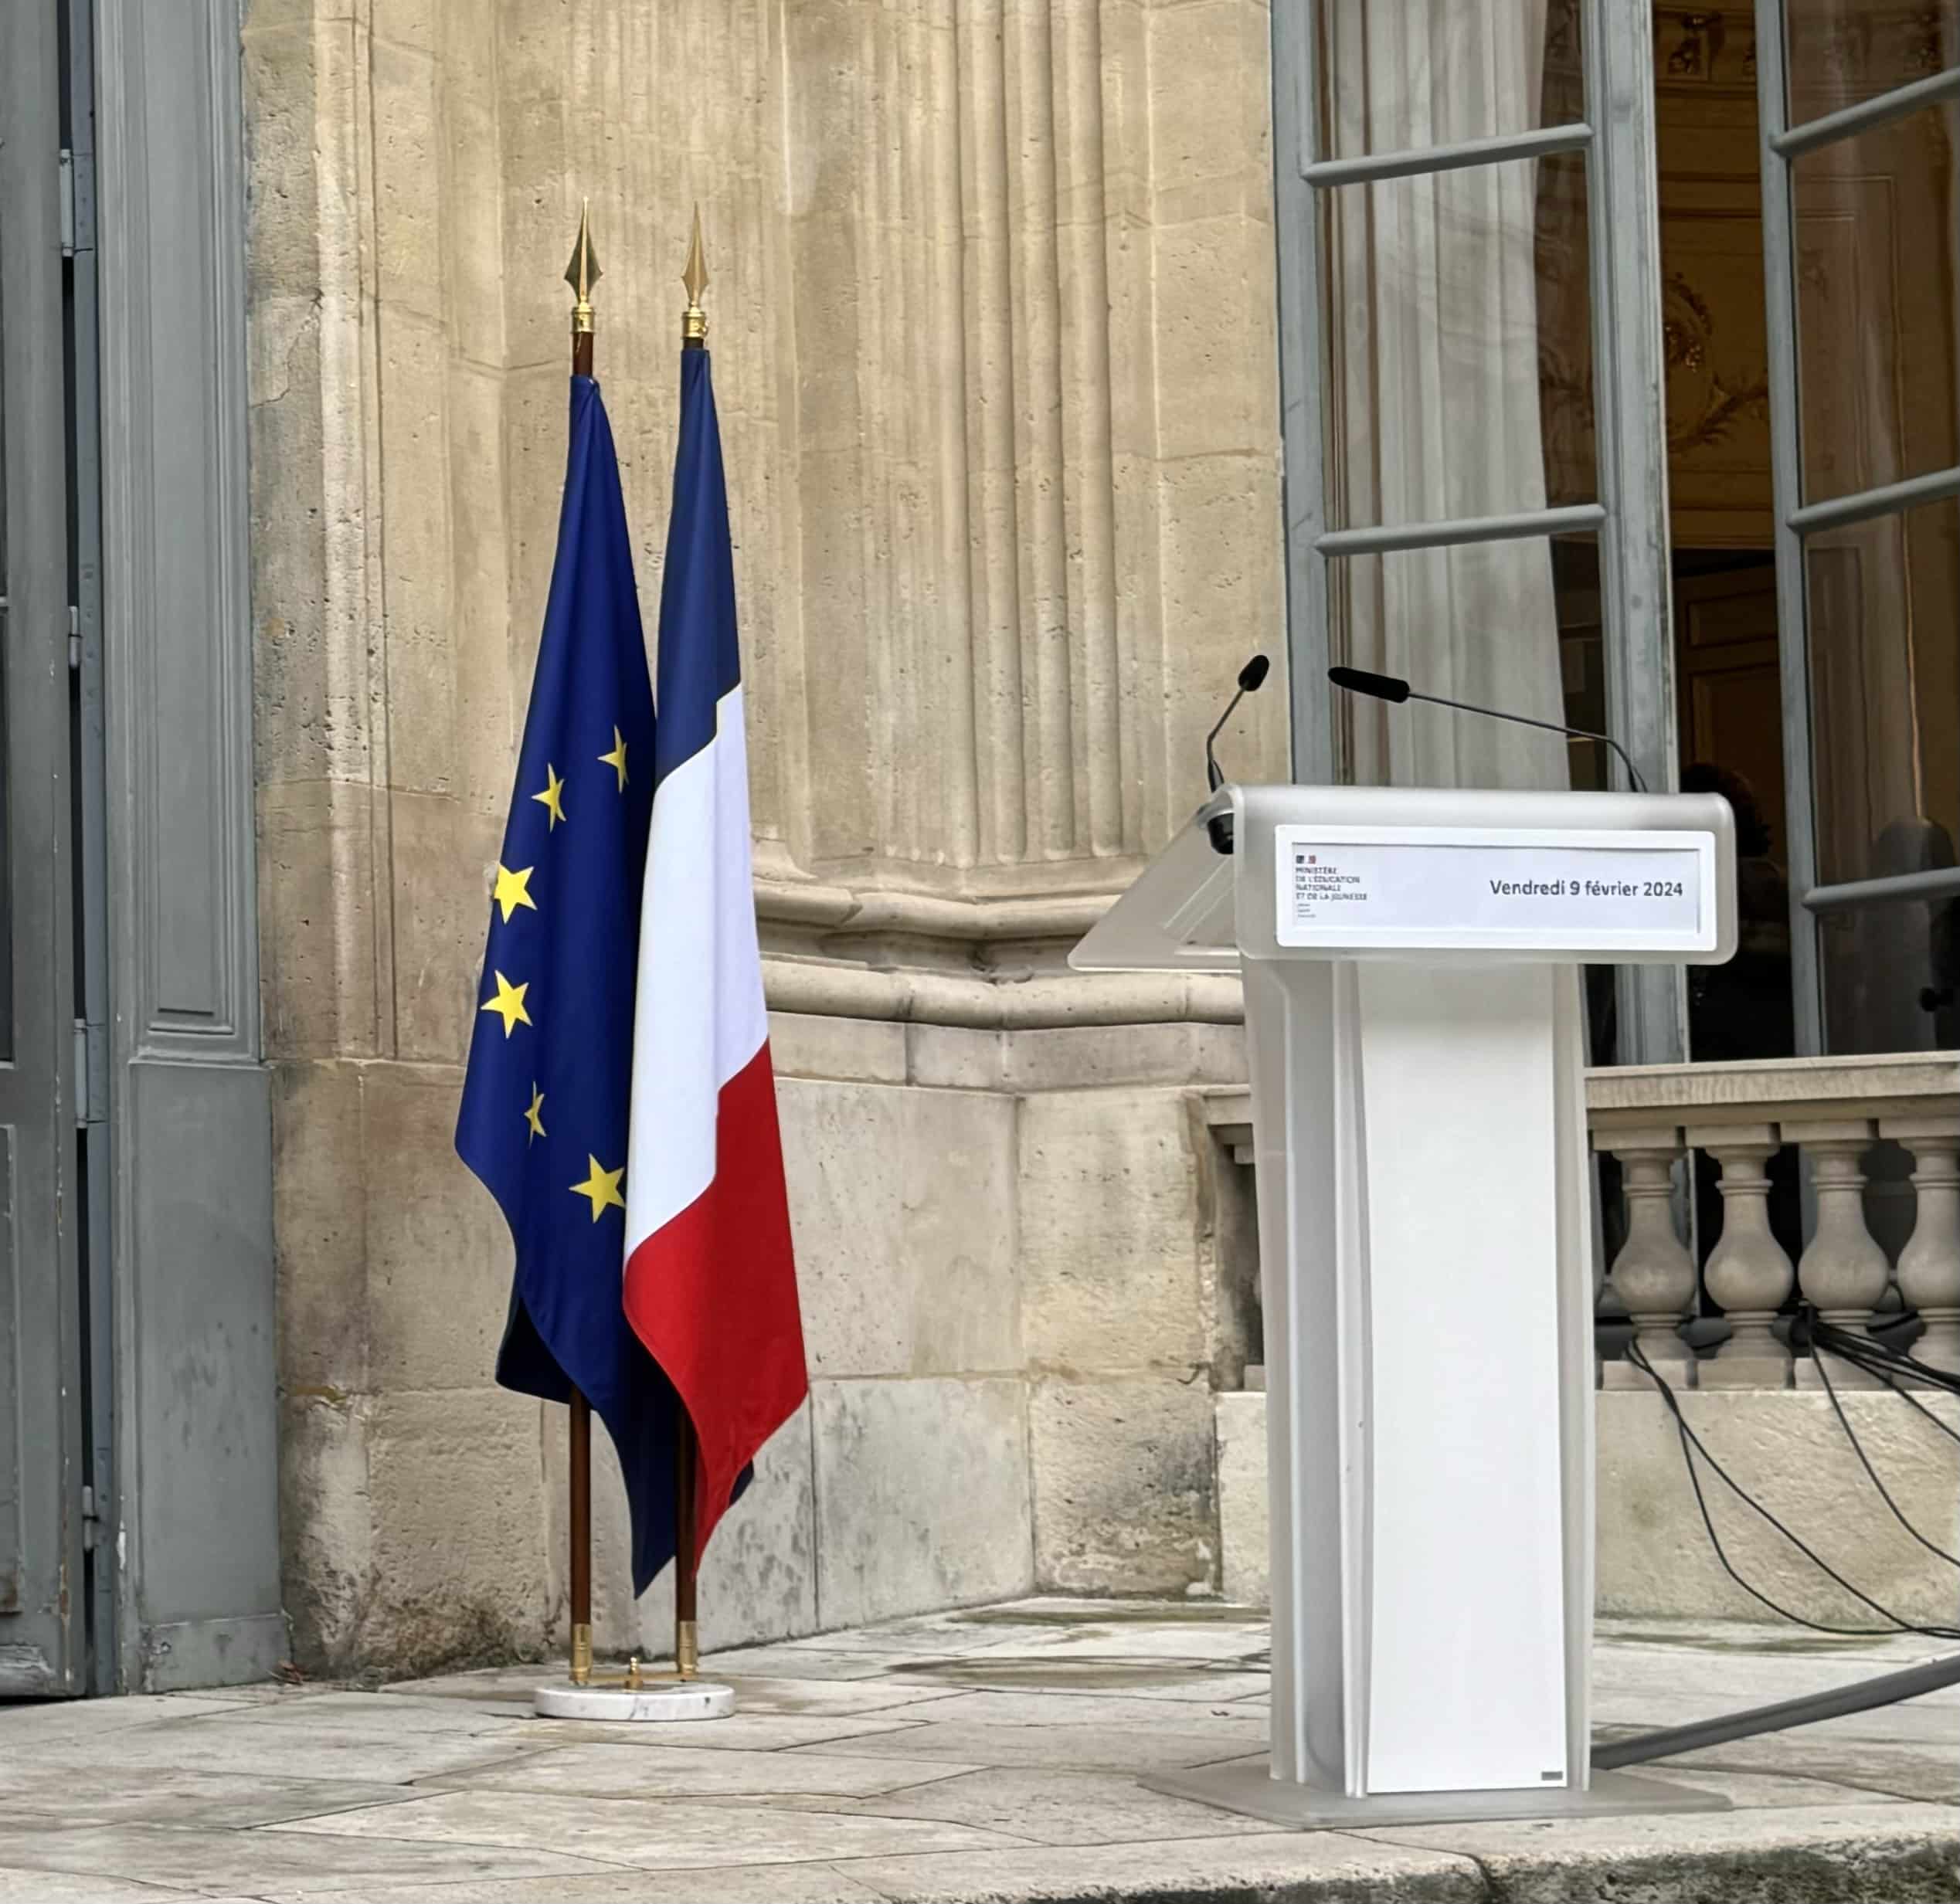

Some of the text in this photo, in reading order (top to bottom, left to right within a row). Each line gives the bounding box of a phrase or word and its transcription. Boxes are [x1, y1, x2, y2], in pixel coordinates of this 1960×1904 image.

[1489, 879, 1683, 898] Vendredi 9 février 2024
